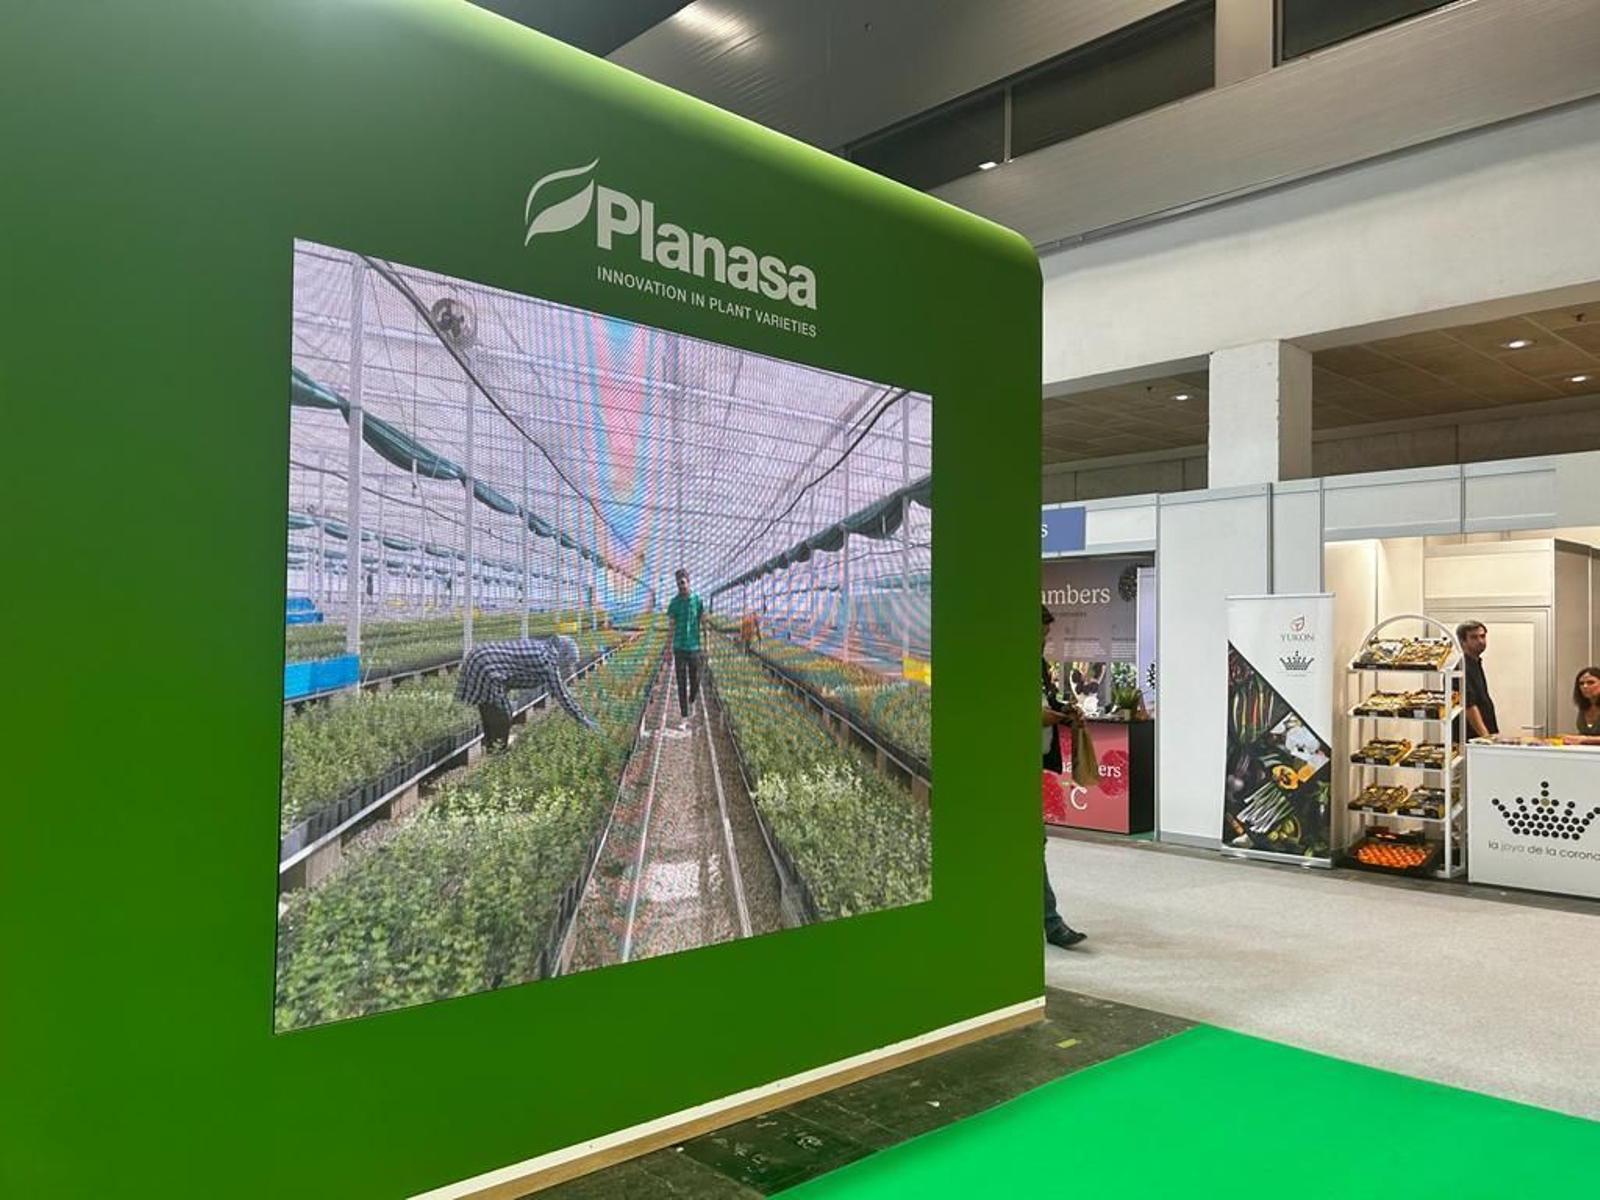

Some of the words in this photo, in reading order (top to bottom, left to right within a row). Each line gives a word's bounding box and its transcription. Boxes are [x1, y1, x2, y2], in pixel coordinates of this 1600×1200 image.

[597, 185, 817, 310] Planasa
[597, 266, 687, 303] INNOVATION
[691, 291, 705, 308] IN
[709, 298, 752, 319] PLANT
[755, 311, 817, 338] VARIETIES
[1488, 840, 1499, 850] la
[1501, 842, 1525, 853] joya
[1527, 845, 1543, 855] de
[1546, 846, 1557, 857] la
[1559, 849, 1600, 862] corona
